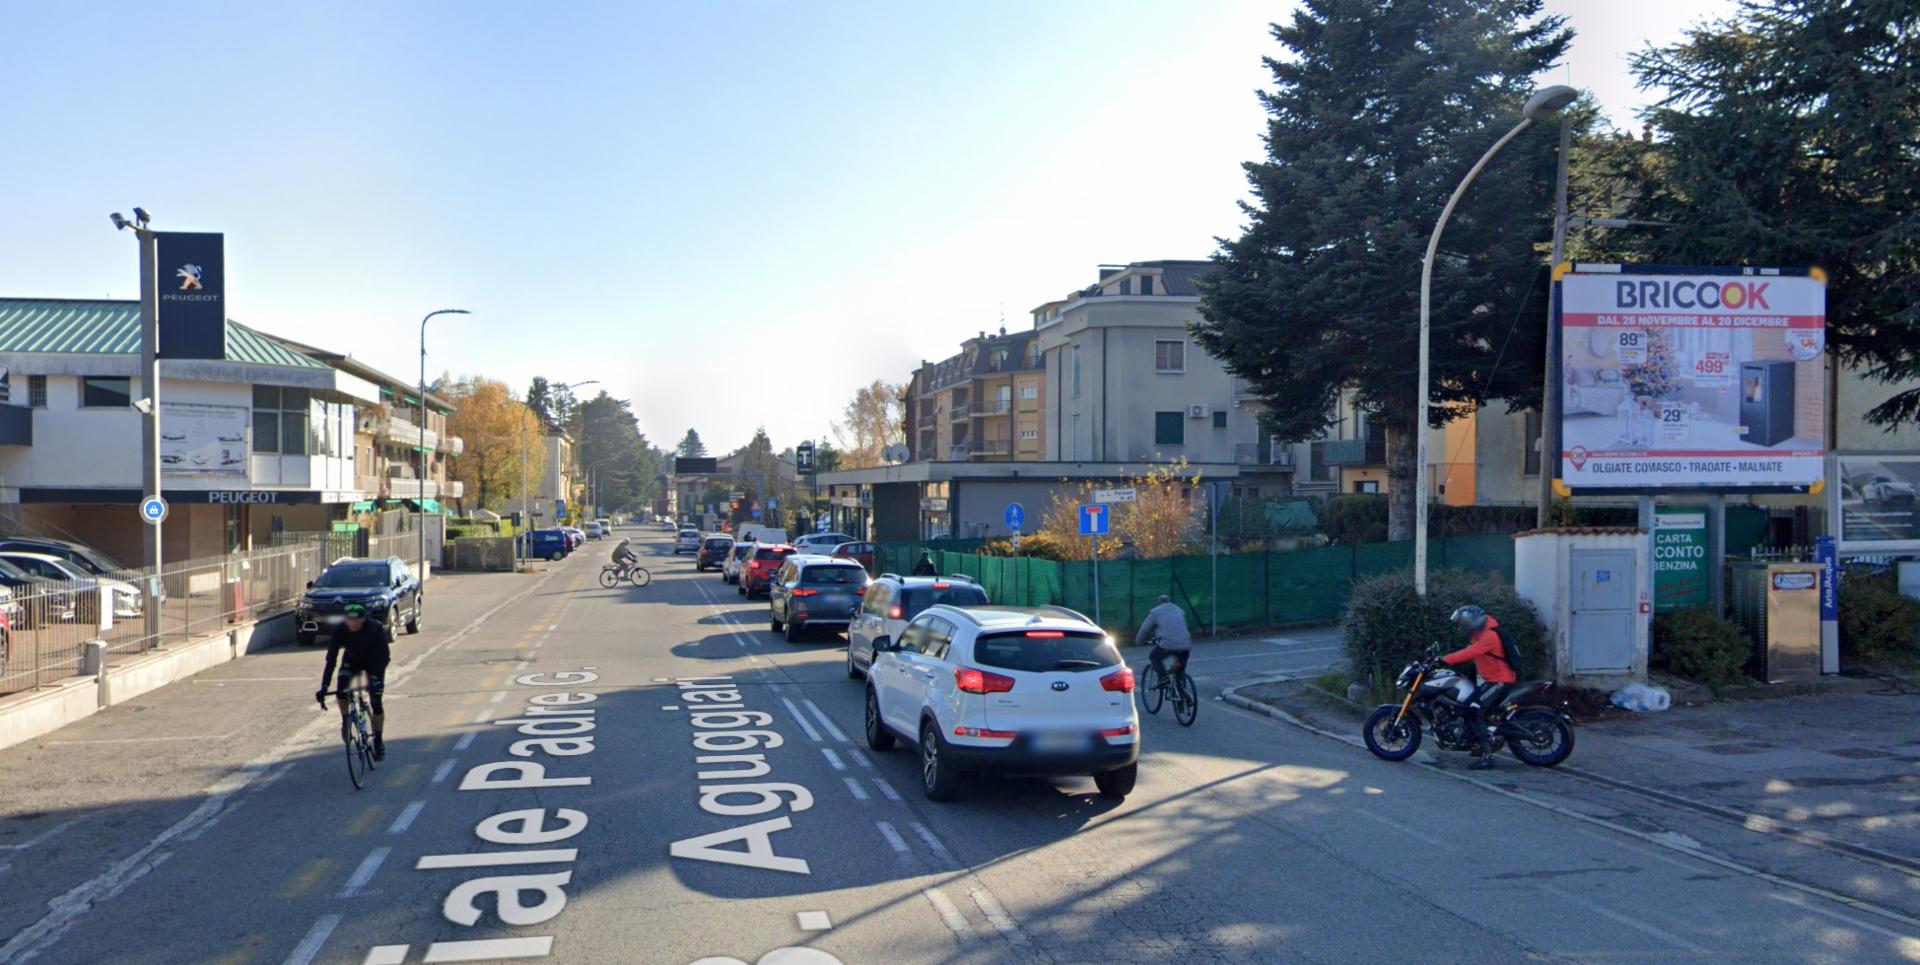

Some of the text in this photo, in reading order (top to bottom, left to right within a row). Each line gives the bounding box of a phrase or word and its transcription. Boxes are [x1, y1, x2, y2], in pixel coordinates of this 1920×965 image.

[163, 294, 219, 302] PEUGEOT
[1597, 315, 1621, 326] DAL
[1638, 316, 1700, 327] NOVEMBRE
[1701, 316, 1716, 327] AL
[1718, 317, 1732, 327] 20
[1734, 317, 1790, 328] DICEMBRE
[1592, 462, 1632, 474] OLGIATE
[1689, 461, 1732, 473] TRADATE
[1738, 461, 1784, 473] MALNATE
[208, 491, 278, 504] PEUGEOT
[1656, 534, 1693, 544] CARTA
[1655, 545, 1704, 558] CONTO
[1824, 557, 1834, 608] Aria/Acqua
